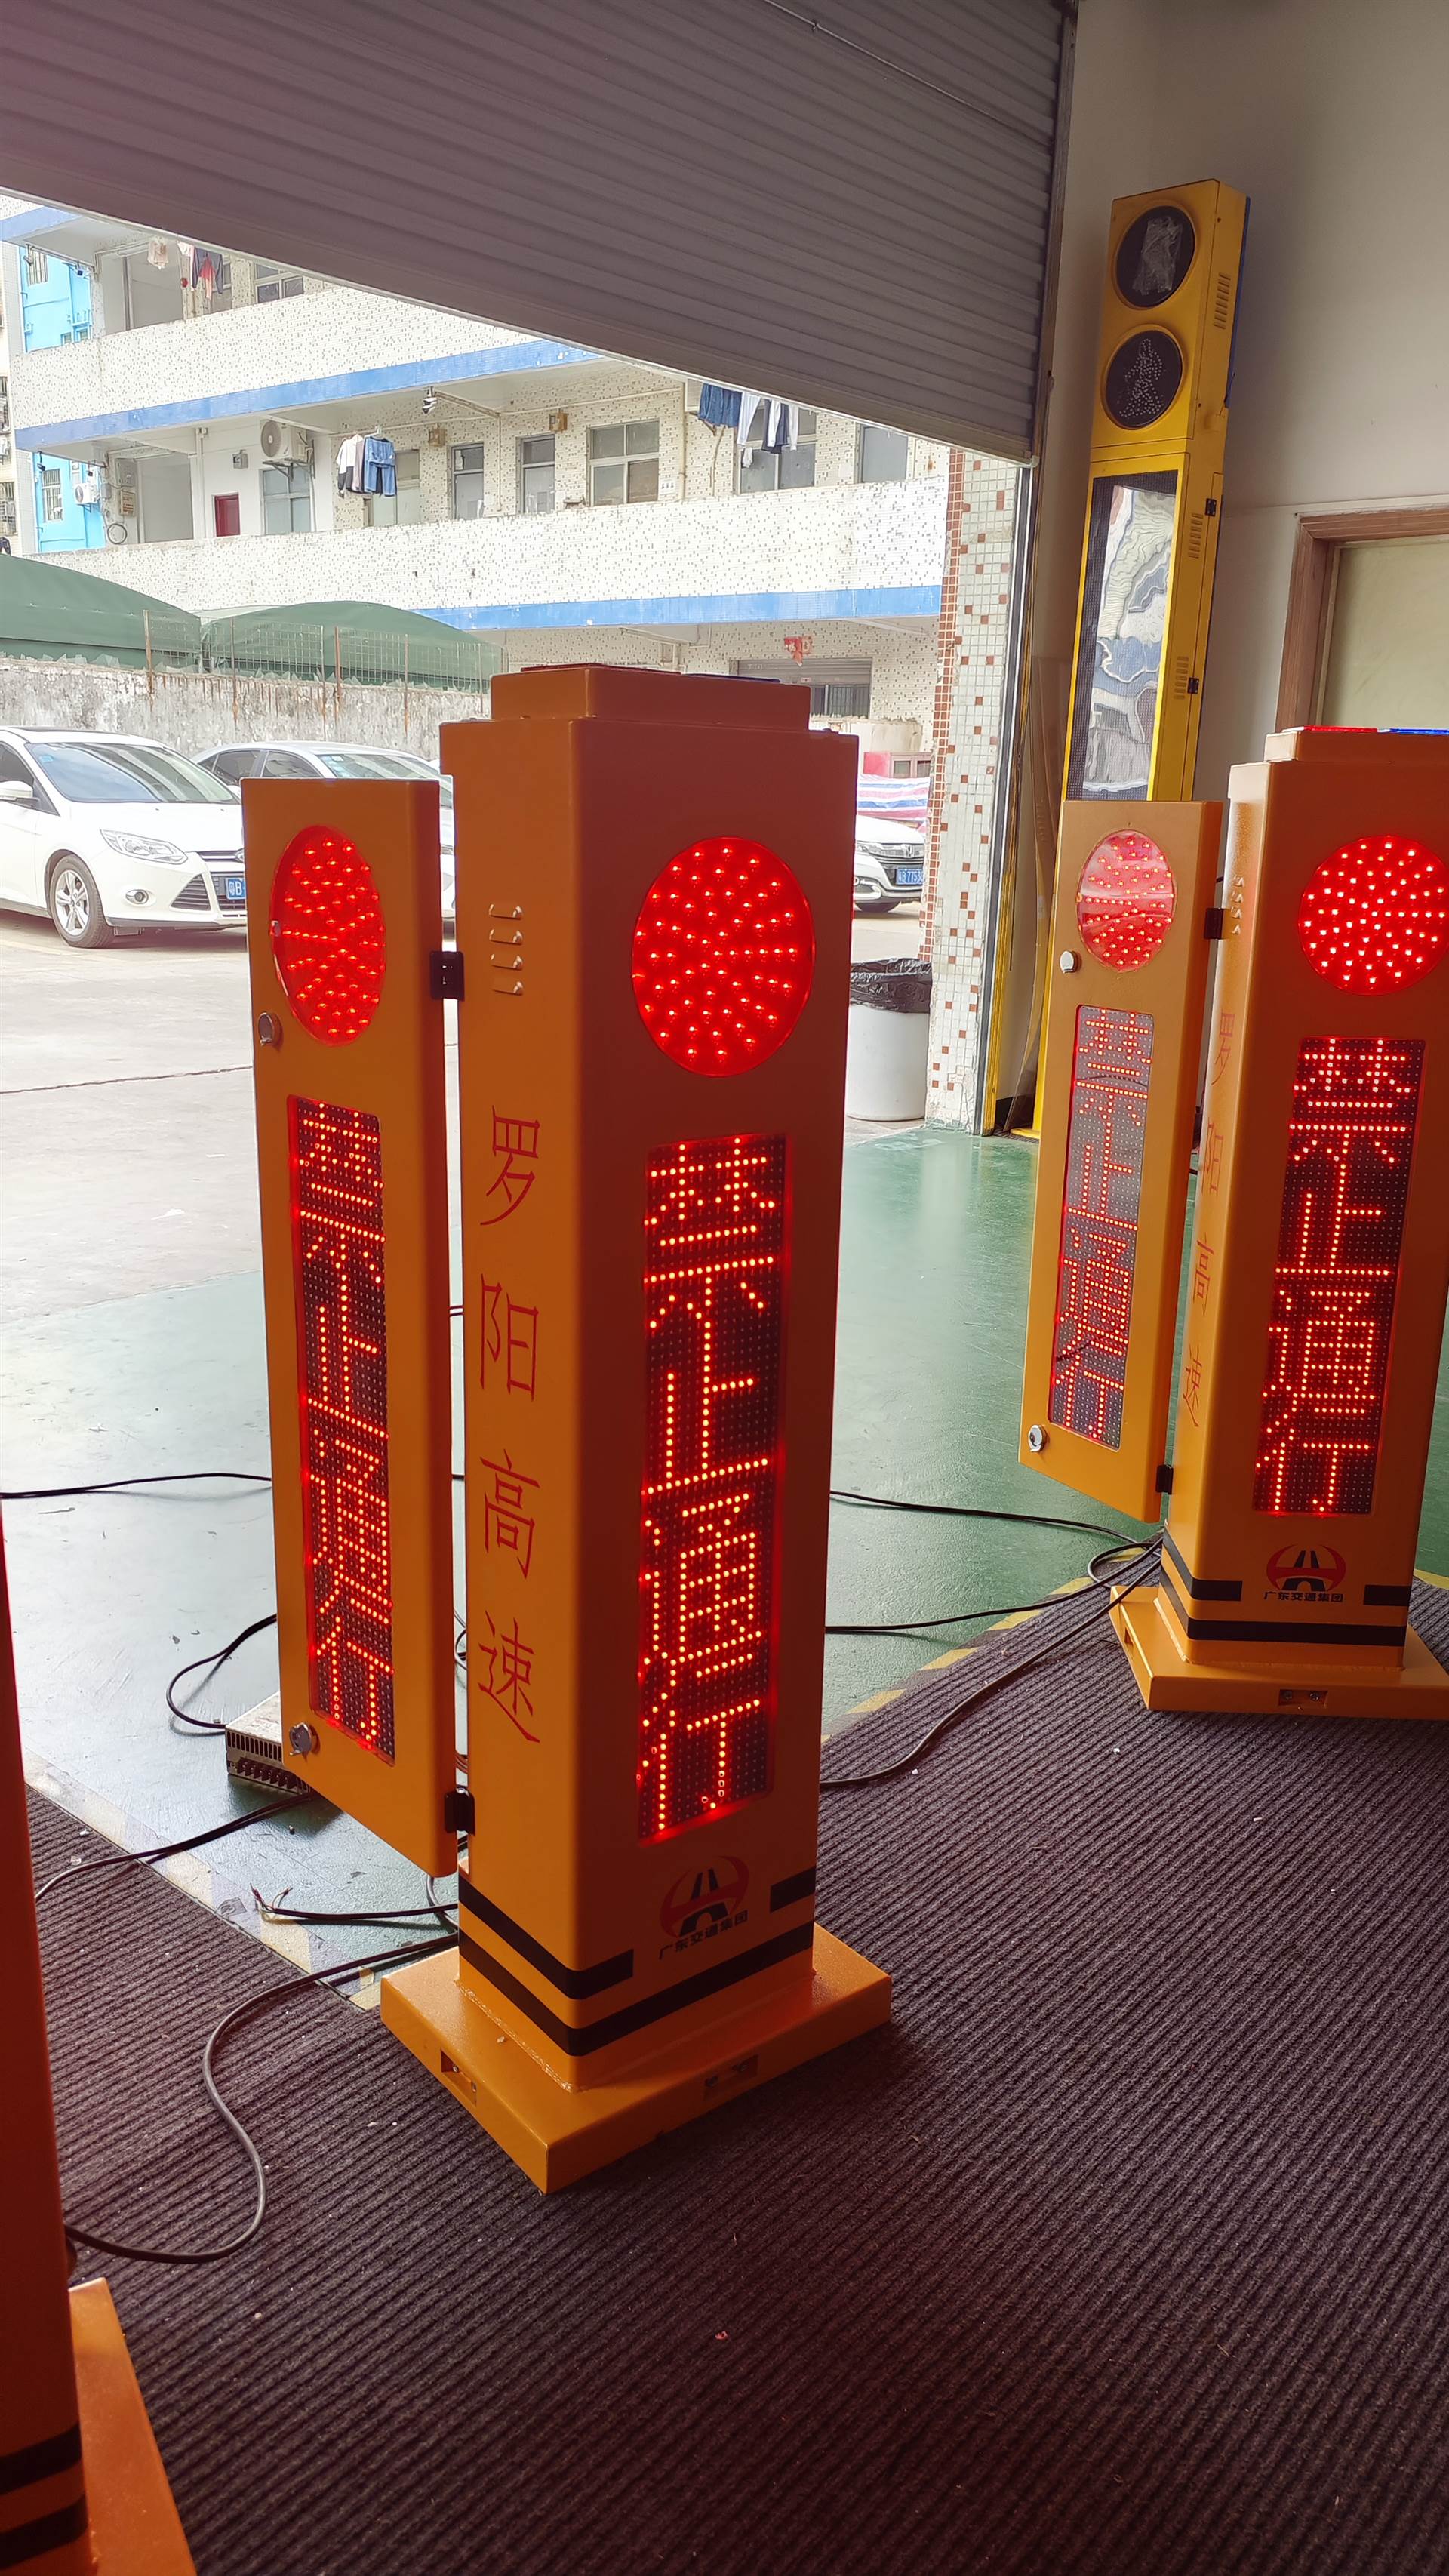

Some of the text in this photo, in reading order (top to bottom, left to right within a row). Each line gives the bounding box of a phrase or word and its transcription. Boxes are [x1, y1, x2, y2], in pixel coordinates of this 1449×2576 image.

[295, 1102, 394, 1745] 禁止通行
[479, 1105, 540, 1744] 罗阳高速
[637, 1137, 777, 1831] 禁止通行
[1054, 1007, 1152, 1439] 禁止通行
[1254, 1037, 1411, 1513] 禁止通行
[1263, 1591, 1343, 1602] 广东交通集团
